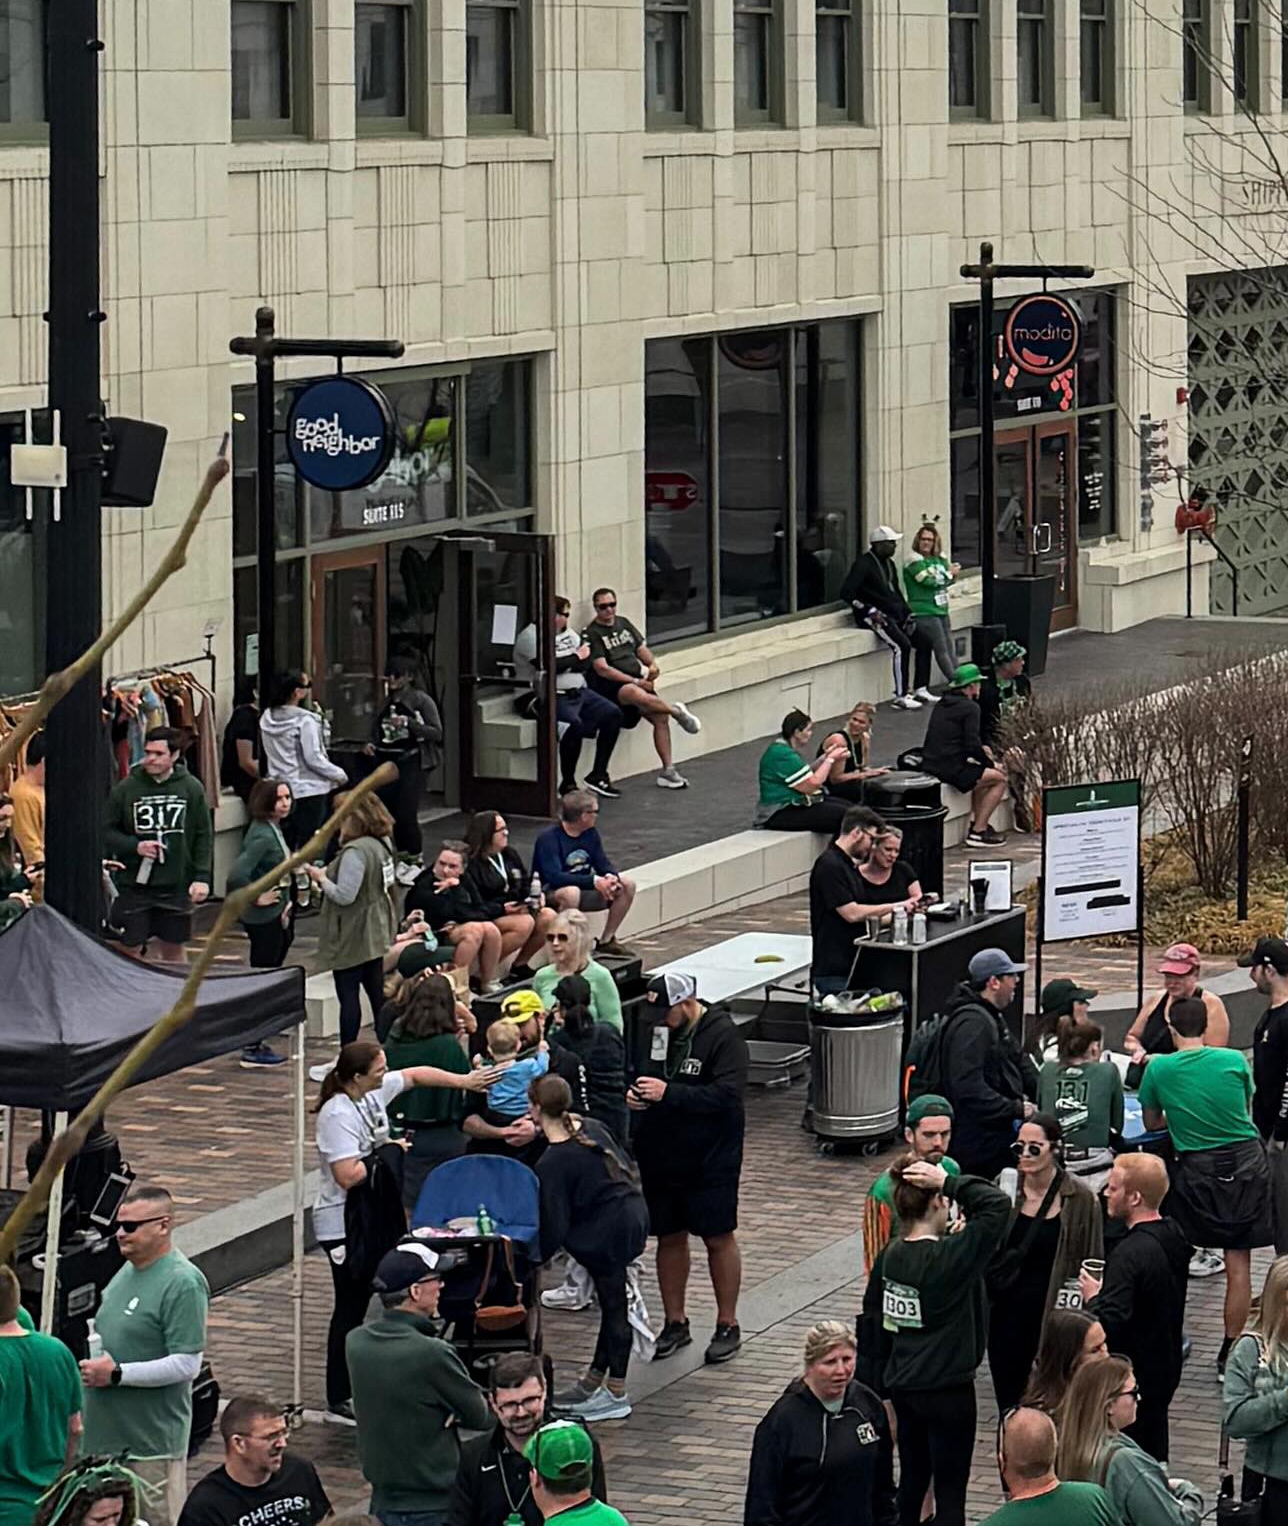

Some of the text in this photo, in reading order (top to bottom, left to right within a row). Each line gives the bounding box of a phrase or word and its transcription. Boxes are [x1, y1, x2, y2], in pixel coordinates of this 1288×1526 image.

[295, 412, 339, 439] good
[303, 428, 381, 456] neighbor
[137, 803, 184, 830] 317
